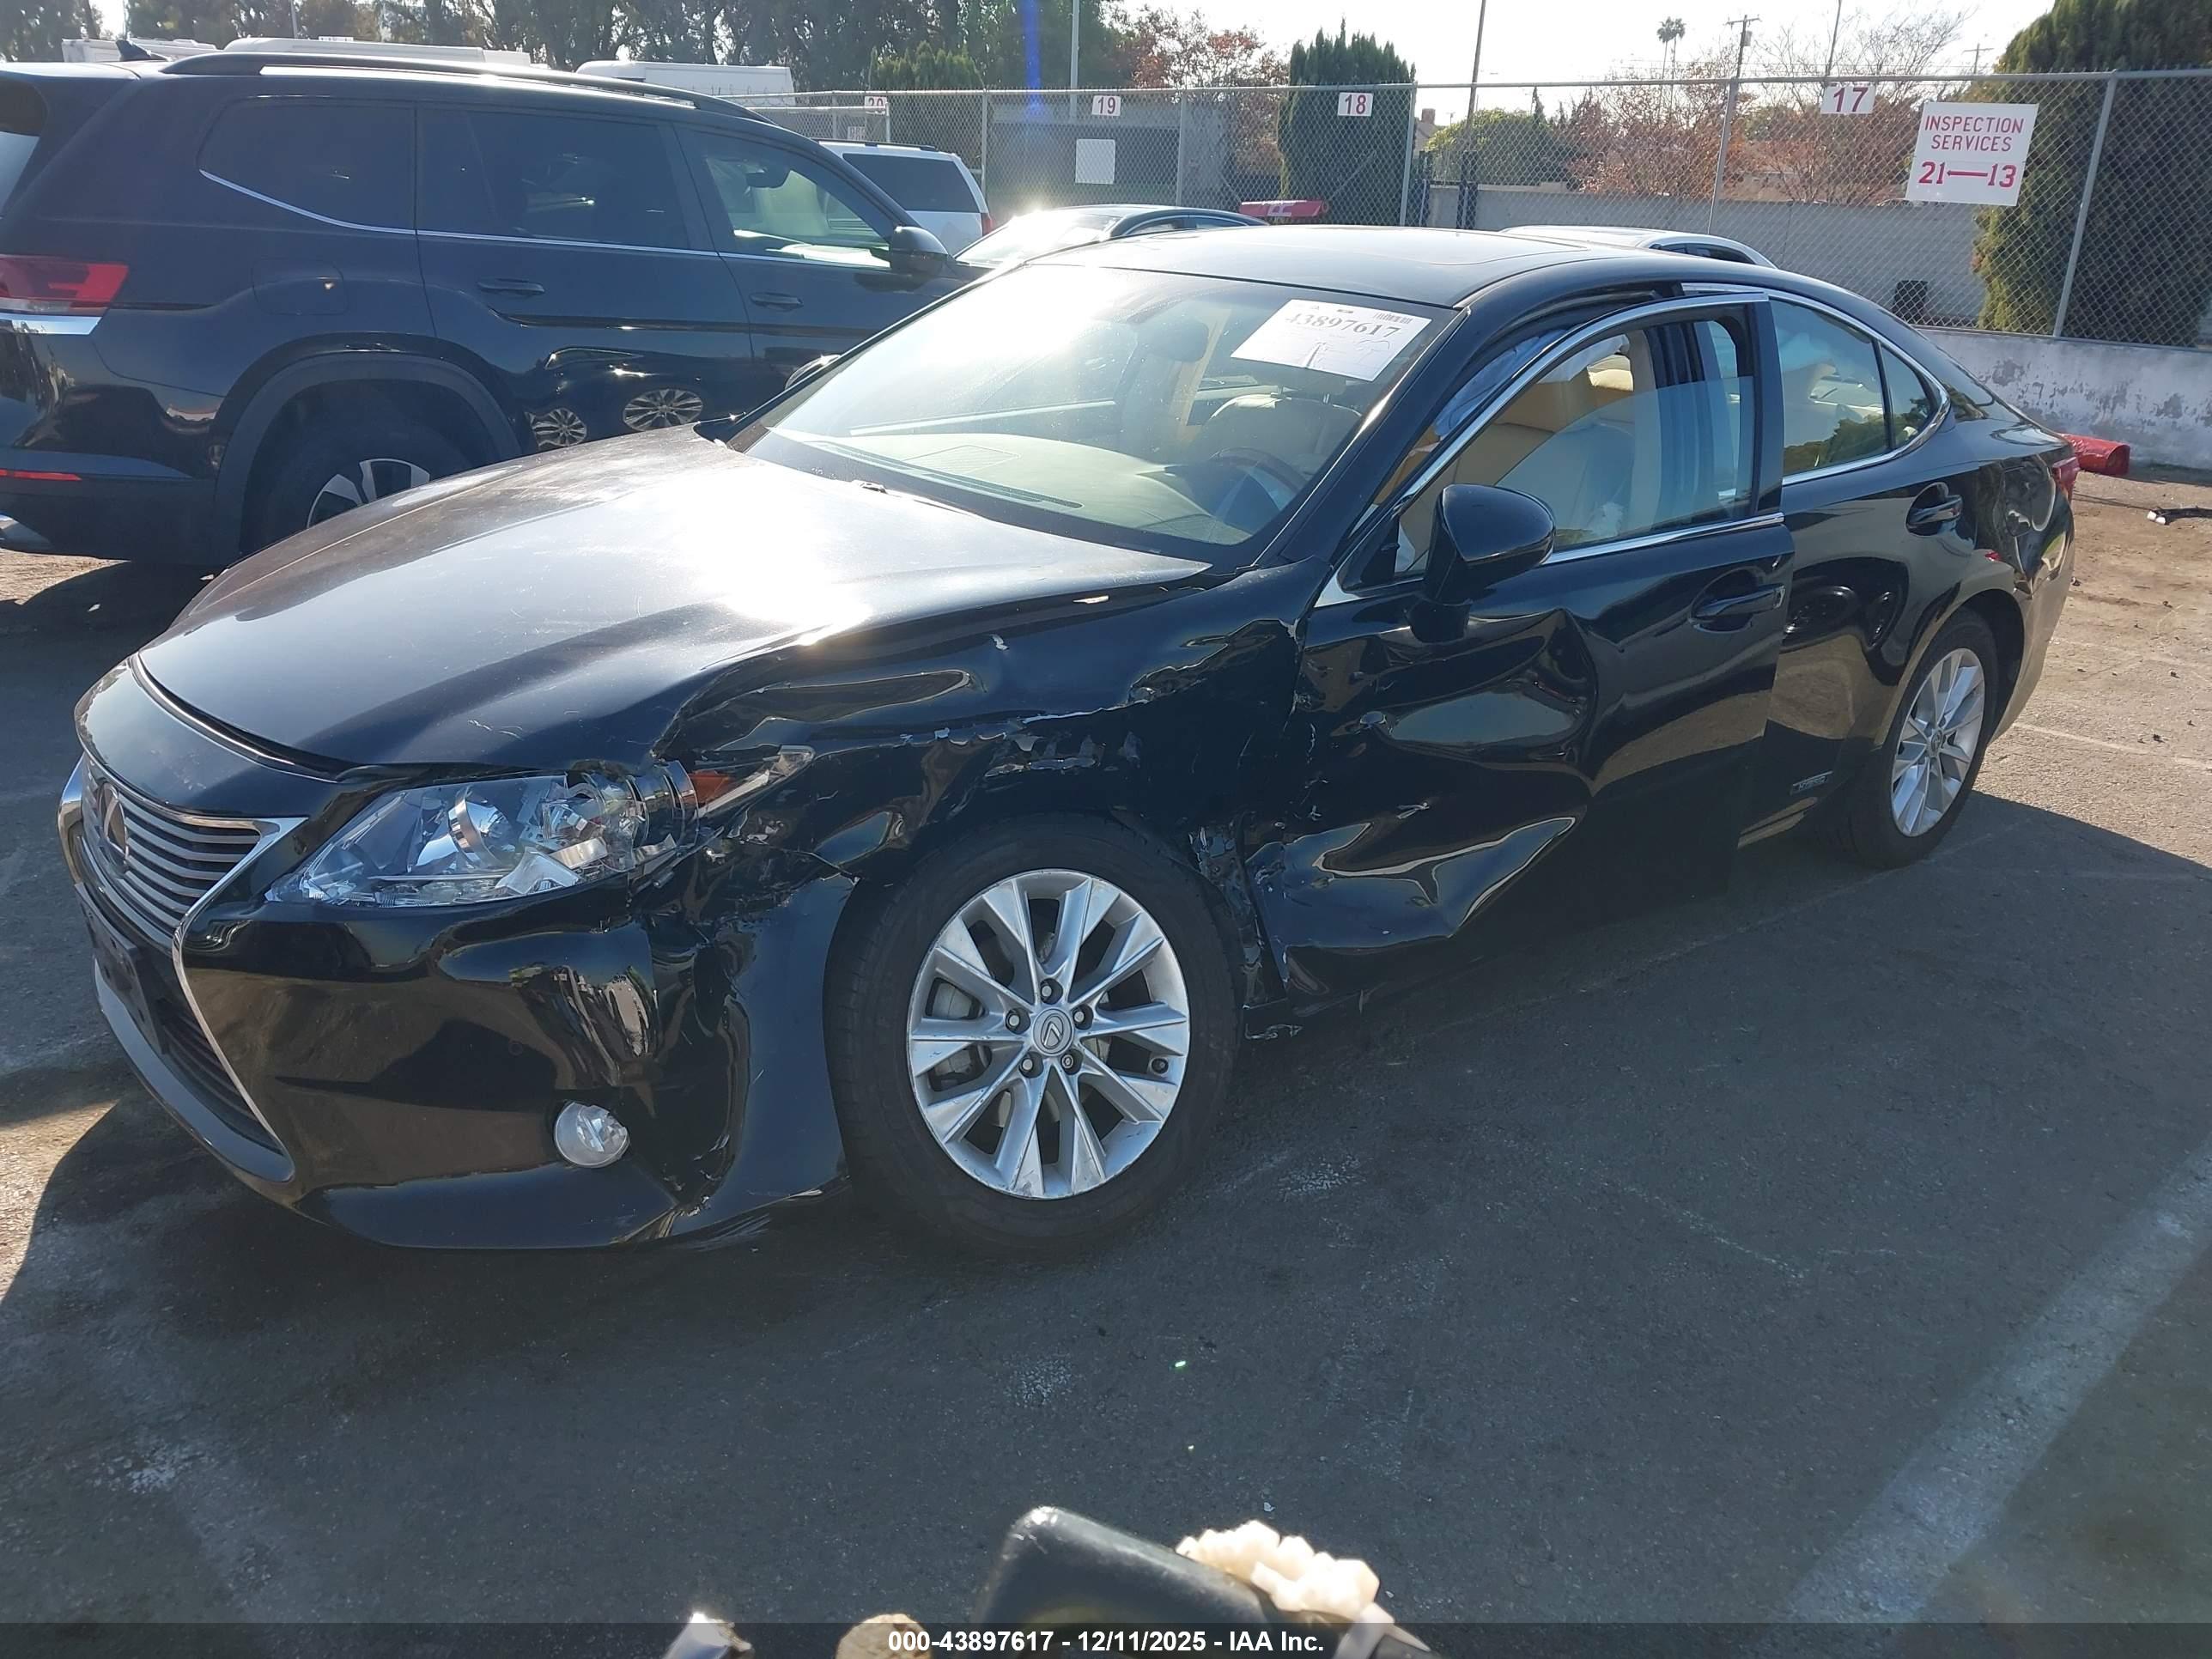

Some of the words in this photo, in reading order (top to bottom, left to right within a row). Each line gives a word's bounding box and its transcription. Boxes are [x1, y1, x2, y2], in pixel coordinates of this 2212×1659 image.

[1097, 96, 1116, 114] 19
[1345, 94, 1367, 114] 18
[1833, 87, 1869, 112] 17
[1924, 115, 2024, 133] INSPECTION
[1931, 134, 2012, 152] SERVICES
